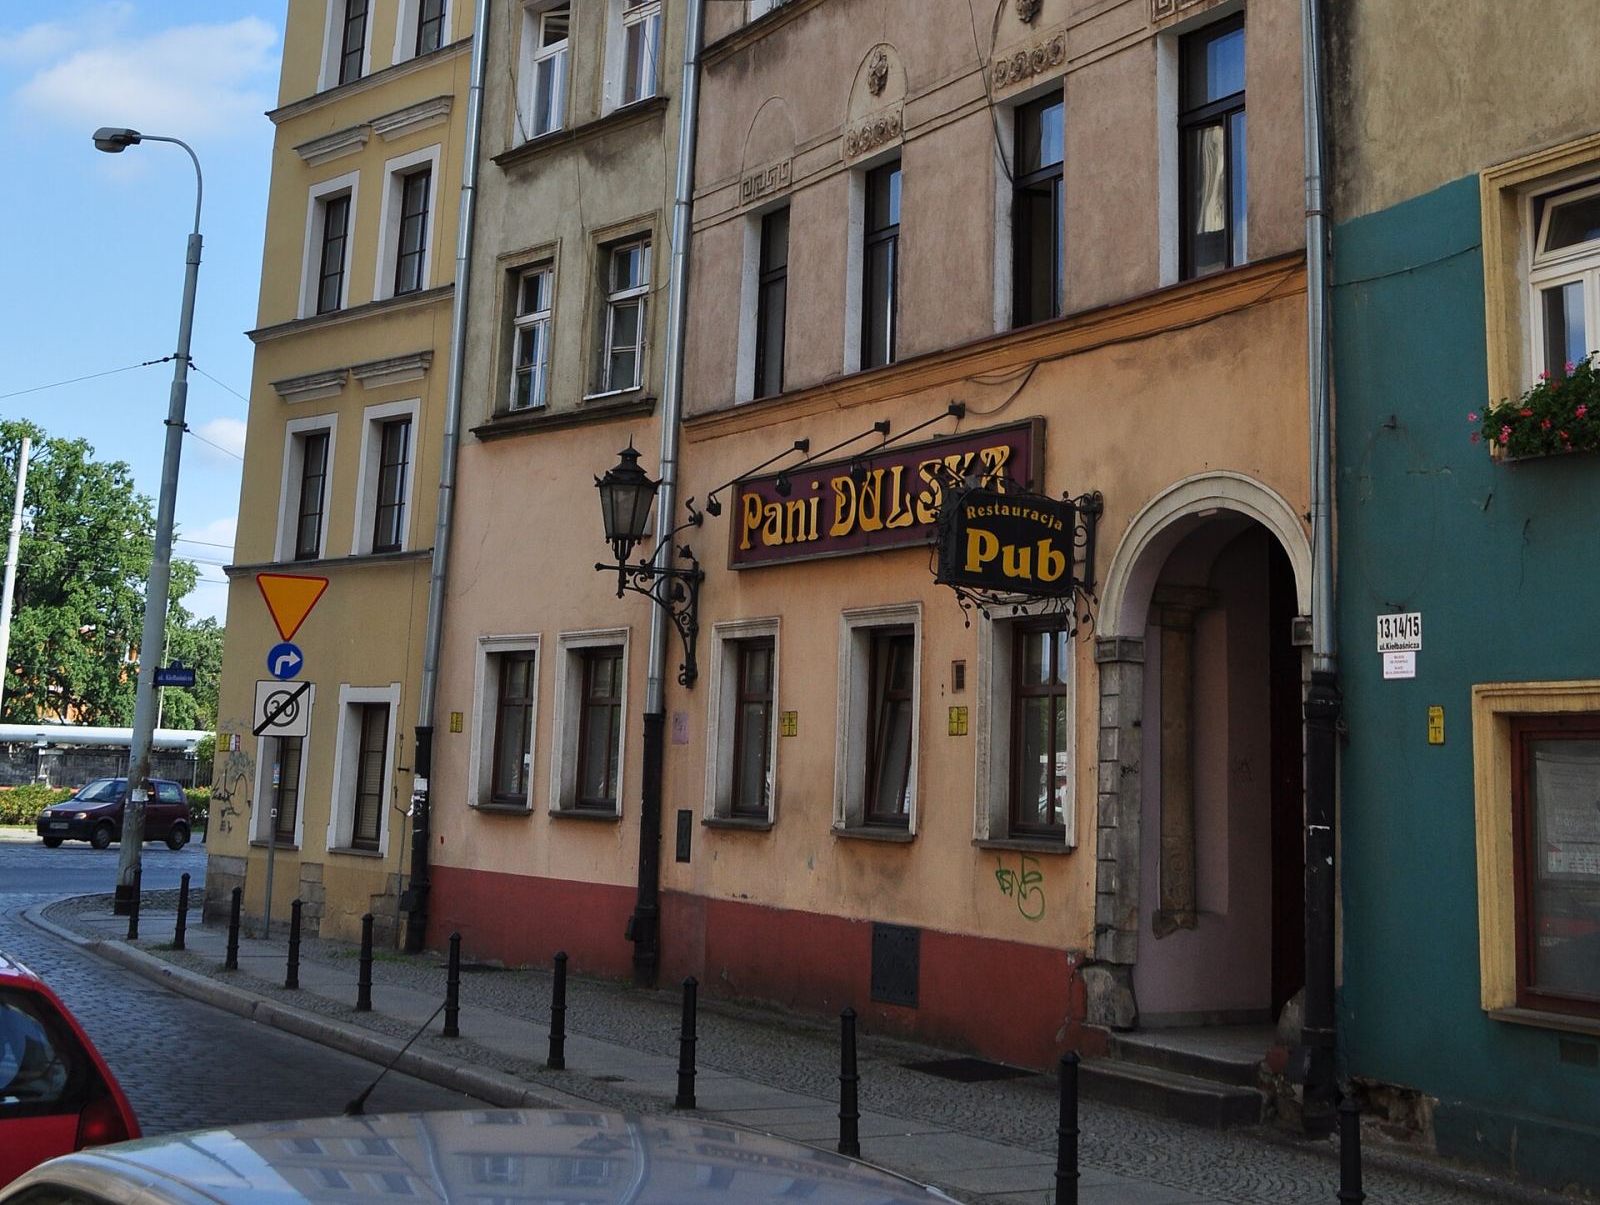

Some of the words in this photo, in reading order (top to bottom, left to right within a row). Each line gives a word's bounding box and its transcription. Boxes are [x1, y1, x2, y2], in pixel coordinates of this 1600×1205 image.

[740, 480, 819, 550] Pani
[967, 500, 1063, 531] Restauracja
[965, 527, 1066, 583] Pub
[1380, 614, 1420, 640] 13,14/15
